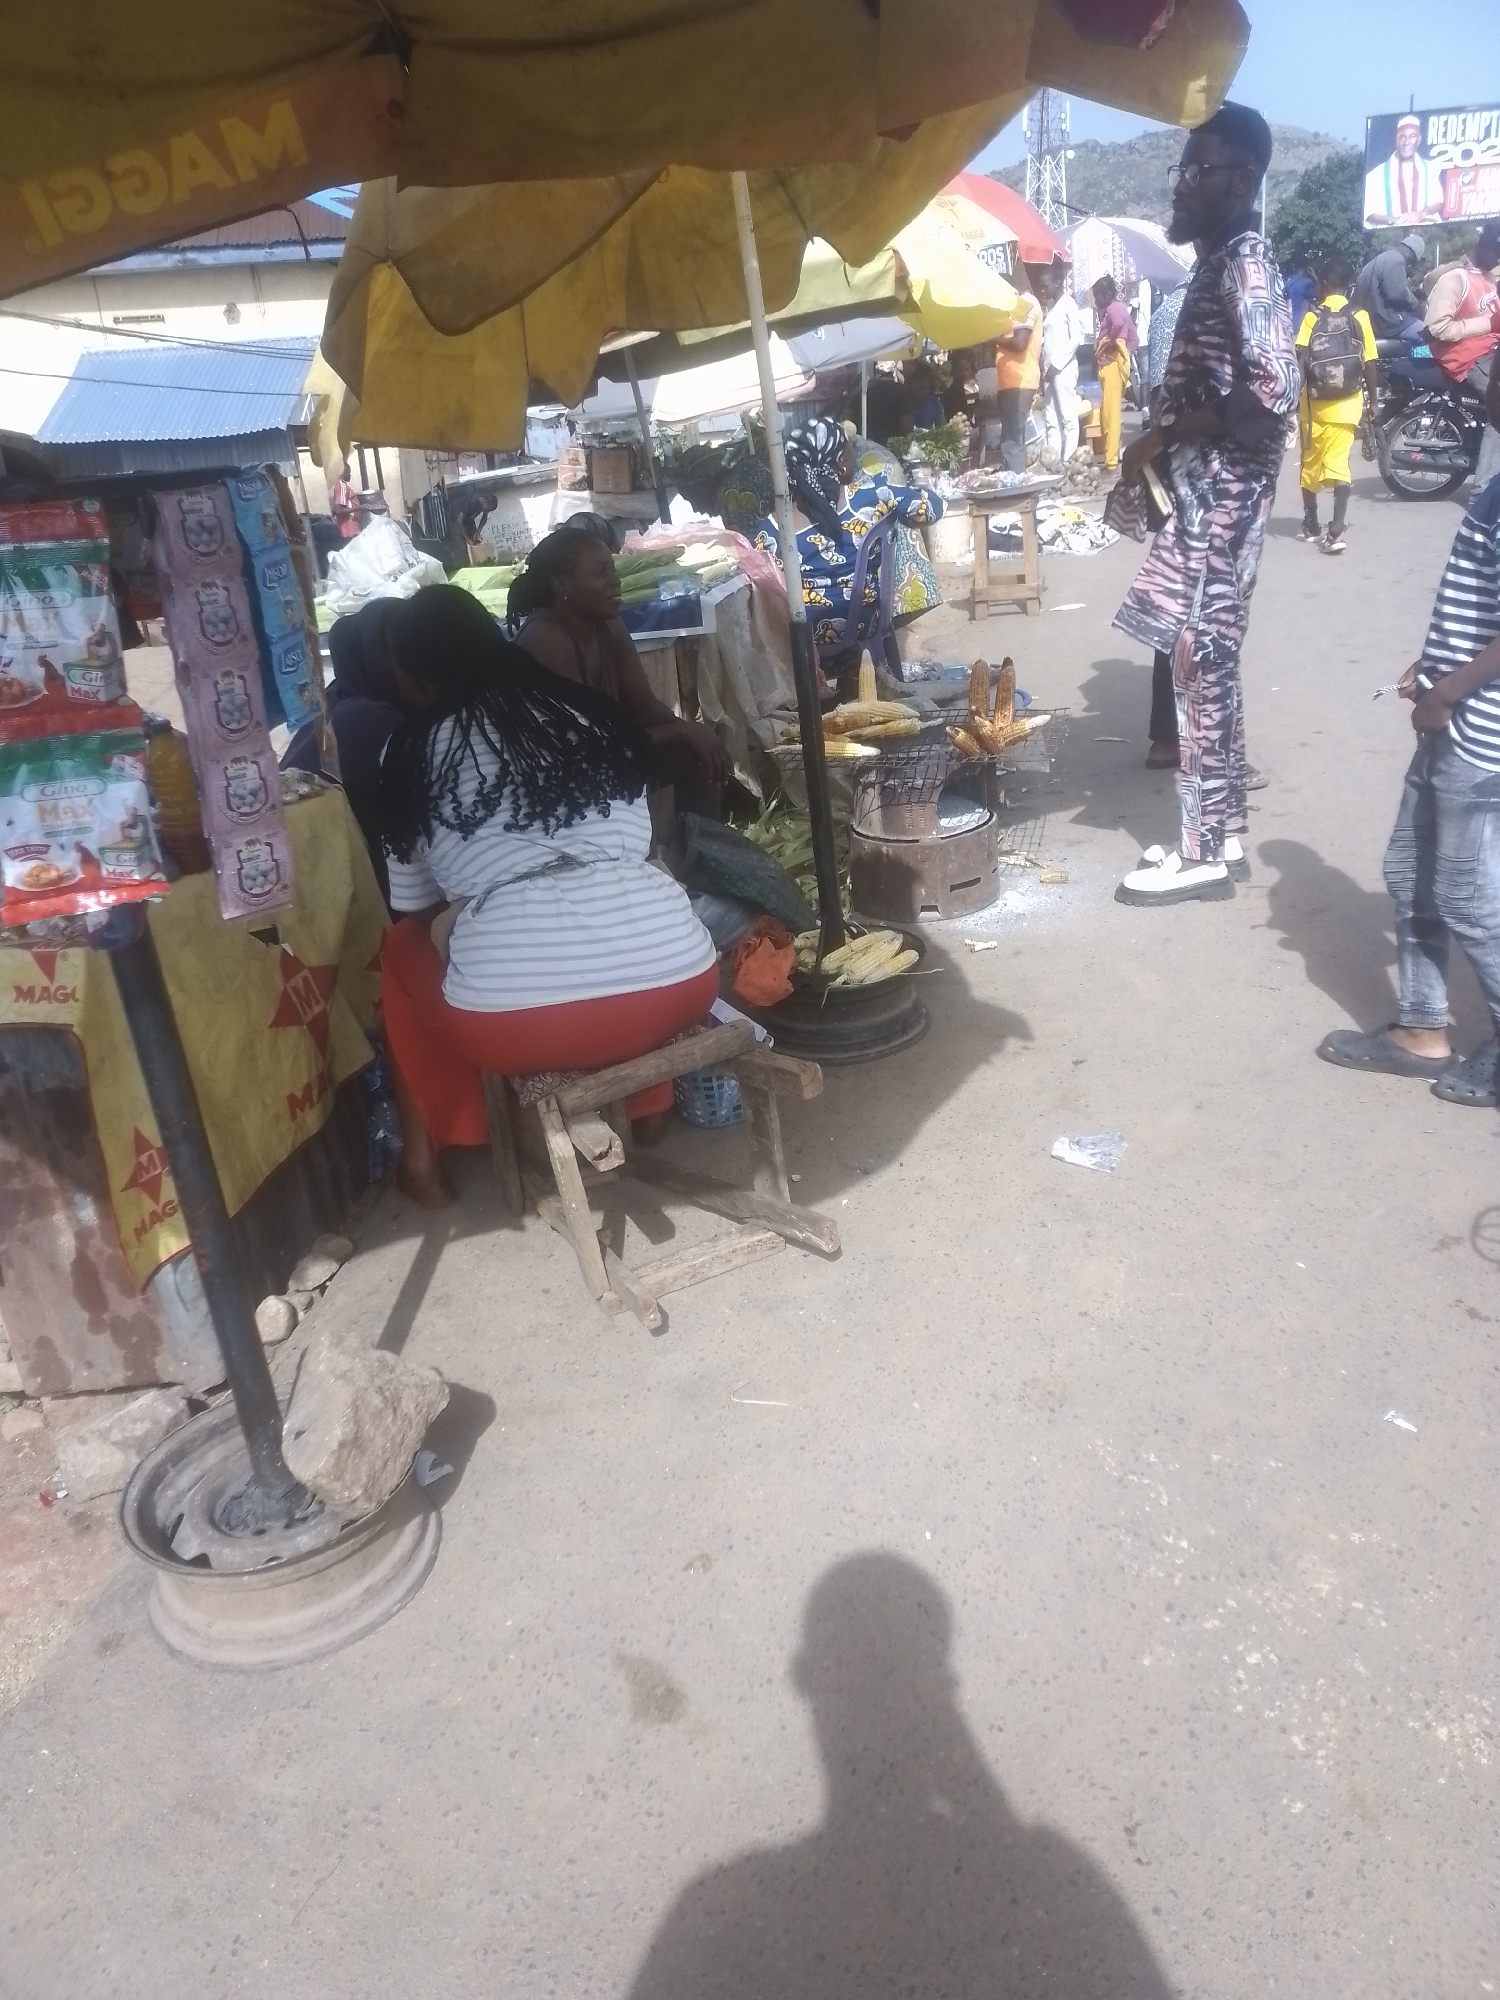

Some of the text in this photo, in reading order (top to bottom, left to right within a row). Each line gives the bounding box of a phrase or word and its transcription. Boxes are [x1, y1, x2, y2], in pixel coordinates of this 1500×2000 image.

[1428, 112, 1500, 146] REDEMPT
[40, 784, 87, 797] Gino
[37, 797, 94, 824] Max
[13, 985, 79, 1005] MAG
[133, 1199, 179, 1243] MAG
